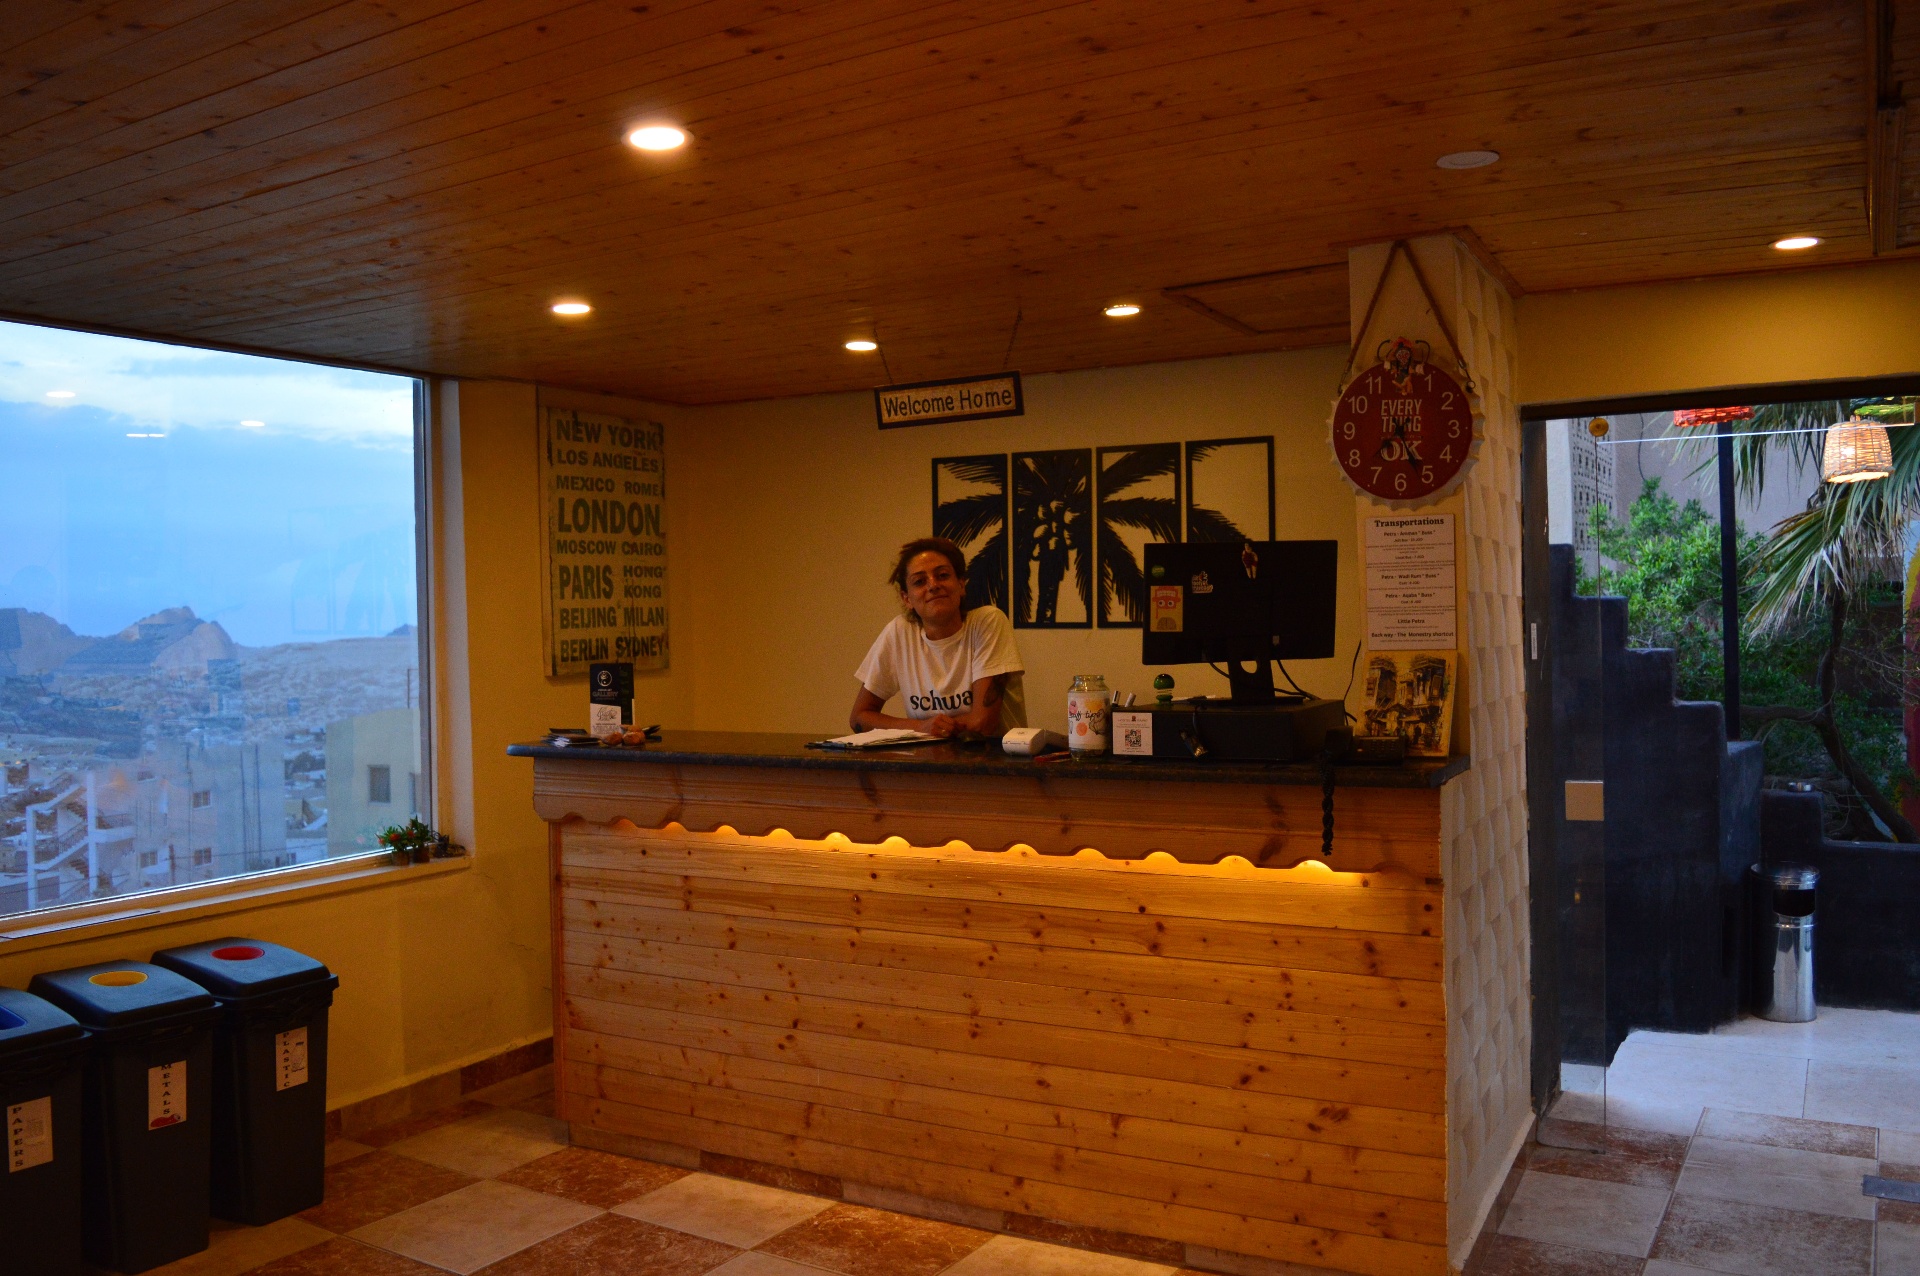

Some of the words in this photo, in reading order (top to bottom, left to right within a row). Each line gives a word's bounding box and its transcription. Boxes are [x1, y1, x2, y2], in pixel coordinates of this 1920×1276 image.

[1365, 376, 1382, 395] 11
[1424, 374, 1432, 393] 1
[884, 395, 955, 417] Welcome
[959, 389, 1013, 410] Home
[1348, 395, 1368, 414] 10
[1381, 399, 1423, 416] EVERY
[1440, 391, 1454, 410] 2
[556, 418, 601, 443] NEW
[607, 424, 663, 451] YORK
[1343, 421, 1356, 440] 9
[1447, 419, 1460, 438] 3
[1349, 449, 1361, 468] 8
[1380, 440, 1423, 461] OK
[1439, 444, 1453, 463] 4
[557, 449, 588, 466] LOS
[592, 451, 660, 472] ANGELES
[1370, 466, 1383, 484] 7
[1394, 473, 1407, 491] 6
[1421, 465, 1433, 484] 5
[556, 475, 615, 493] MEXICO
[624, 481, 660, 496] ROME
[557, 497, 661, 536] LONDON
[1374, 517, 1445, 528] Transportations
[556, 539, 617, 555] MOSCOW
[621, 541, 662, 556] CAIRO
[558, 565, 614, 600] PARIS
[623, 565, 663, 579] HONG
[623, 585, 662, 599] KONG
[560, 606, 617, 629] BEIJING
[623, 606, 665, 627] MILAN
[561, 637, 609, 662] BERLIN
[615, 635, 665, 658] SYDNEY
[282, 1030, 291, 1088] PLASTIC
[161, 1062, 172, 1115] METALS
[12, 1106, 24, 1168] PAPERS
